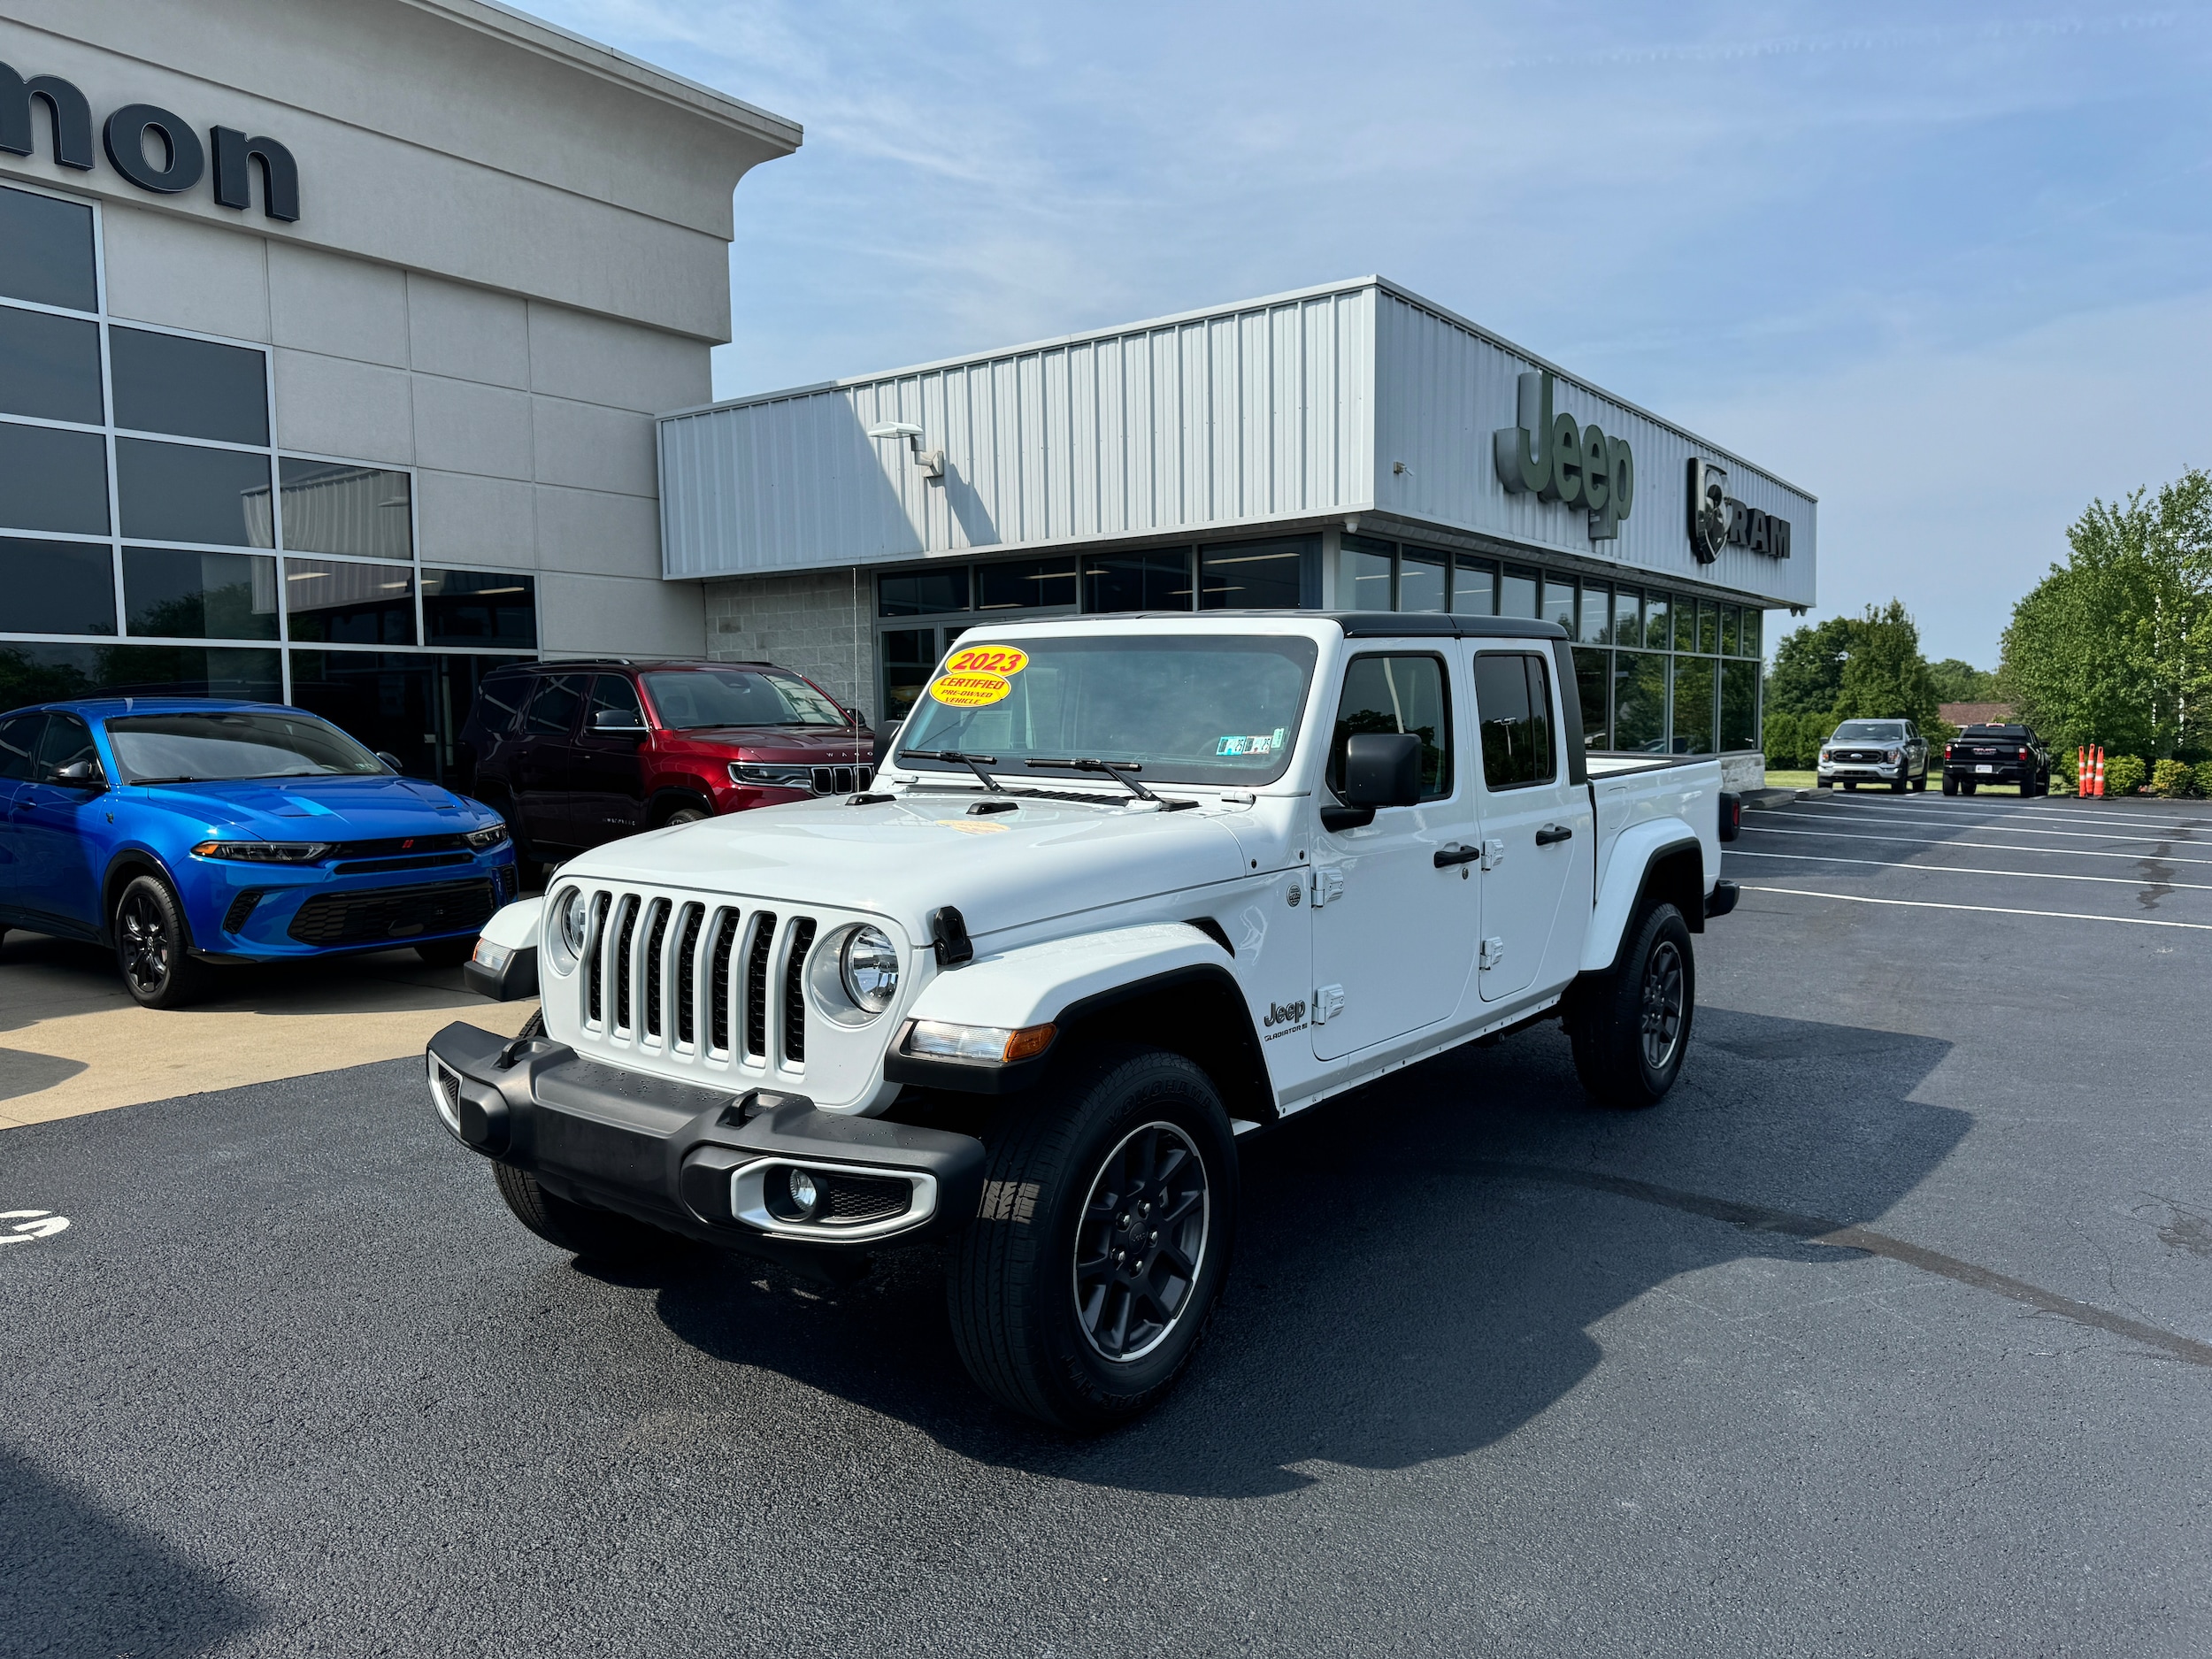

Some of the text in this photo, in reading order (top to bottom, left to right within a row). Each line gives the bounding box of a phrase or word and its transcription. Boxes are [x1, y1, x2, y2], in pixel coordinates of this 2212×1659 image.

[1495, 370, 1633, 539] Jeep
[1729, 497, 1790, 558] RAM
[952, 653, 1022, 672] 2023
[940, 677, 1006, 690] CERTIFIED
[941, 689, 993, 698] PRE-OWNED
[1264, 1000, 1306, 1027] Jeep
[1263, 1025, 1302, 1042] GLADIATOR
[1106, 1078, 1212, 1127] YOKOHAMA
